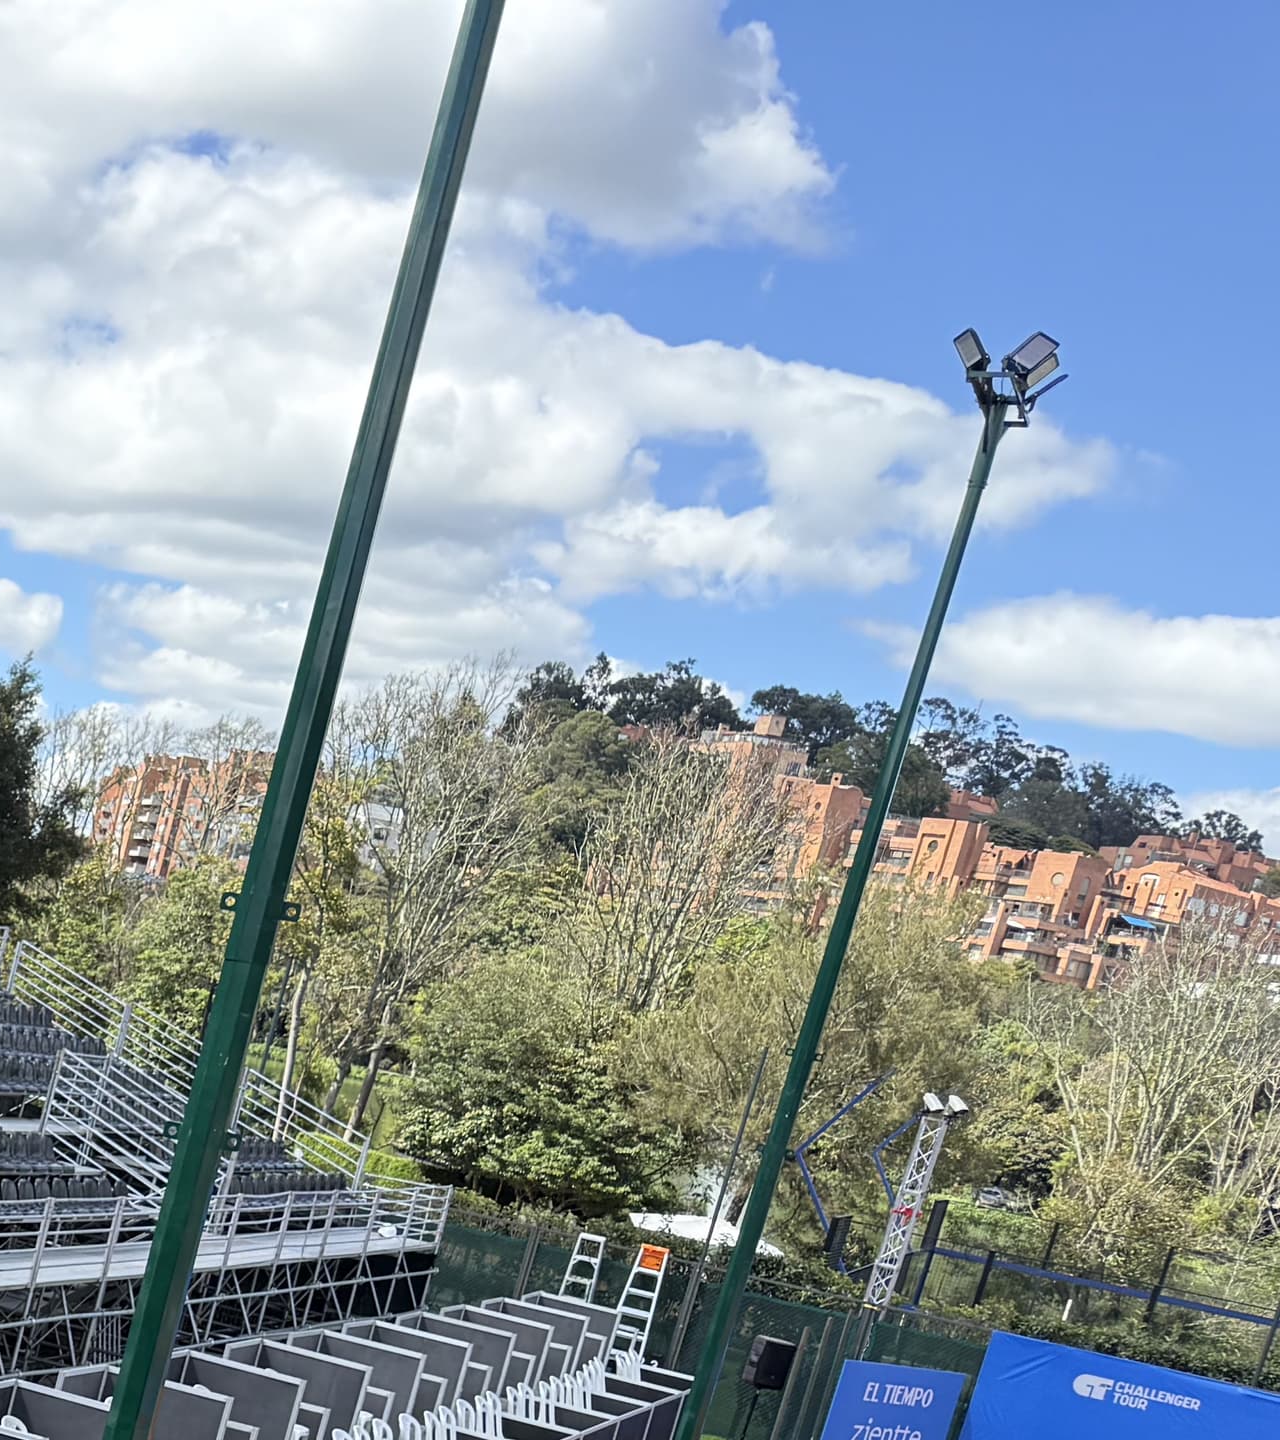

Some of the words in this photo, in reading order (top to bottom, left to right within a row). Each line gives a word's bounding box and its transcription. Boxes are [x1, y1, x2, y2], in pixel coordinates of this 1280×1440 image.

[864, 1382, 879, 1402] EL
[883, 1384, 934, 1408] TIEMPO
[1113, 1392, 1148, 1411] TOUR
[1115, 1381, 1201, 1410] CHALLENGER
